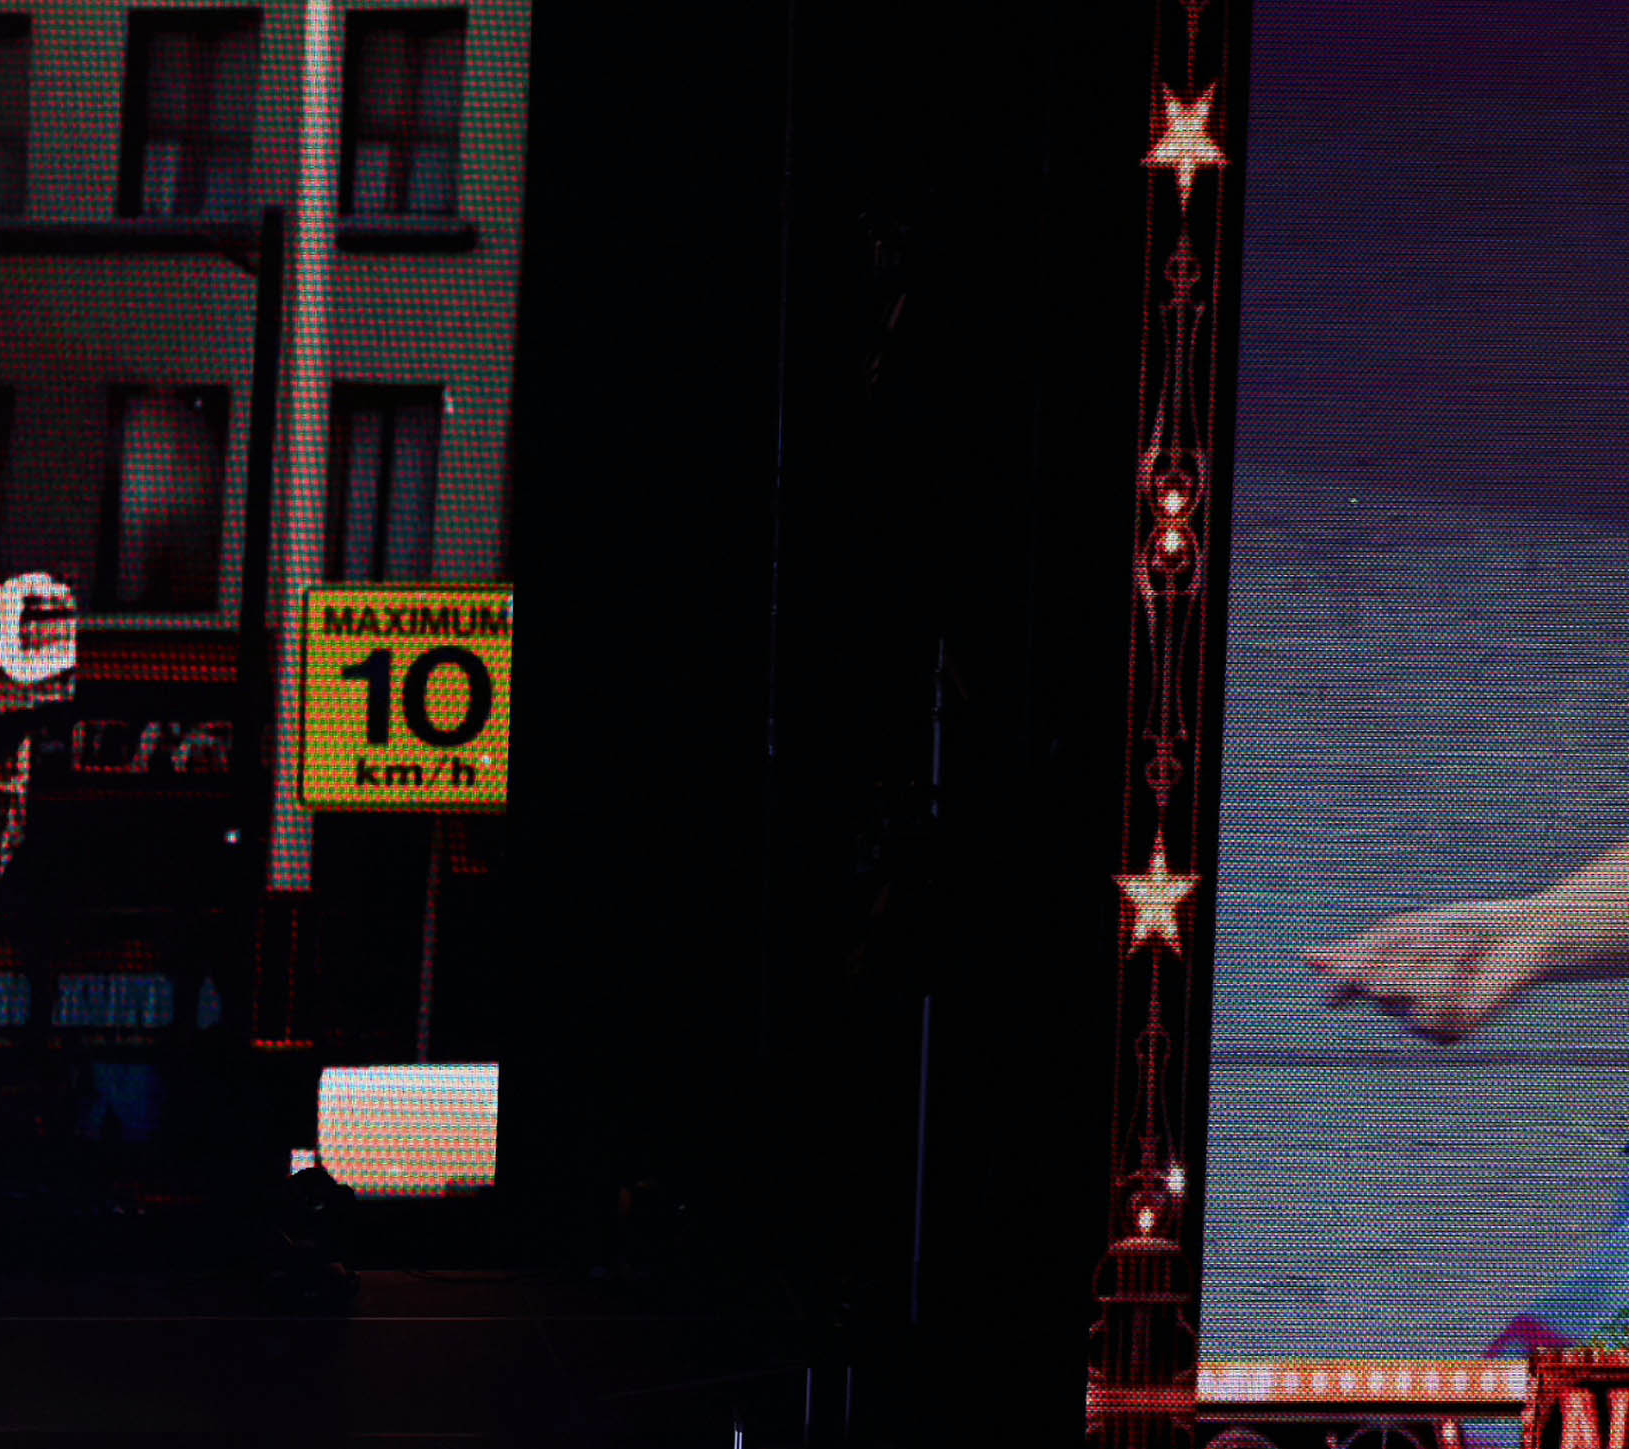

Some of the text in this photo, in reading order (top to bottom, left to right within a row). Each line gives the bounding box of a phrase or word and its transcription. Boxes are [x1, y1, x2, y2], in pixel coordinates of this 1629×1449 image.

[322, 603, 512, 637] MAXIMUM
[341, 645, 494, 748] 10
[354, 757, 477, 788] km/h
